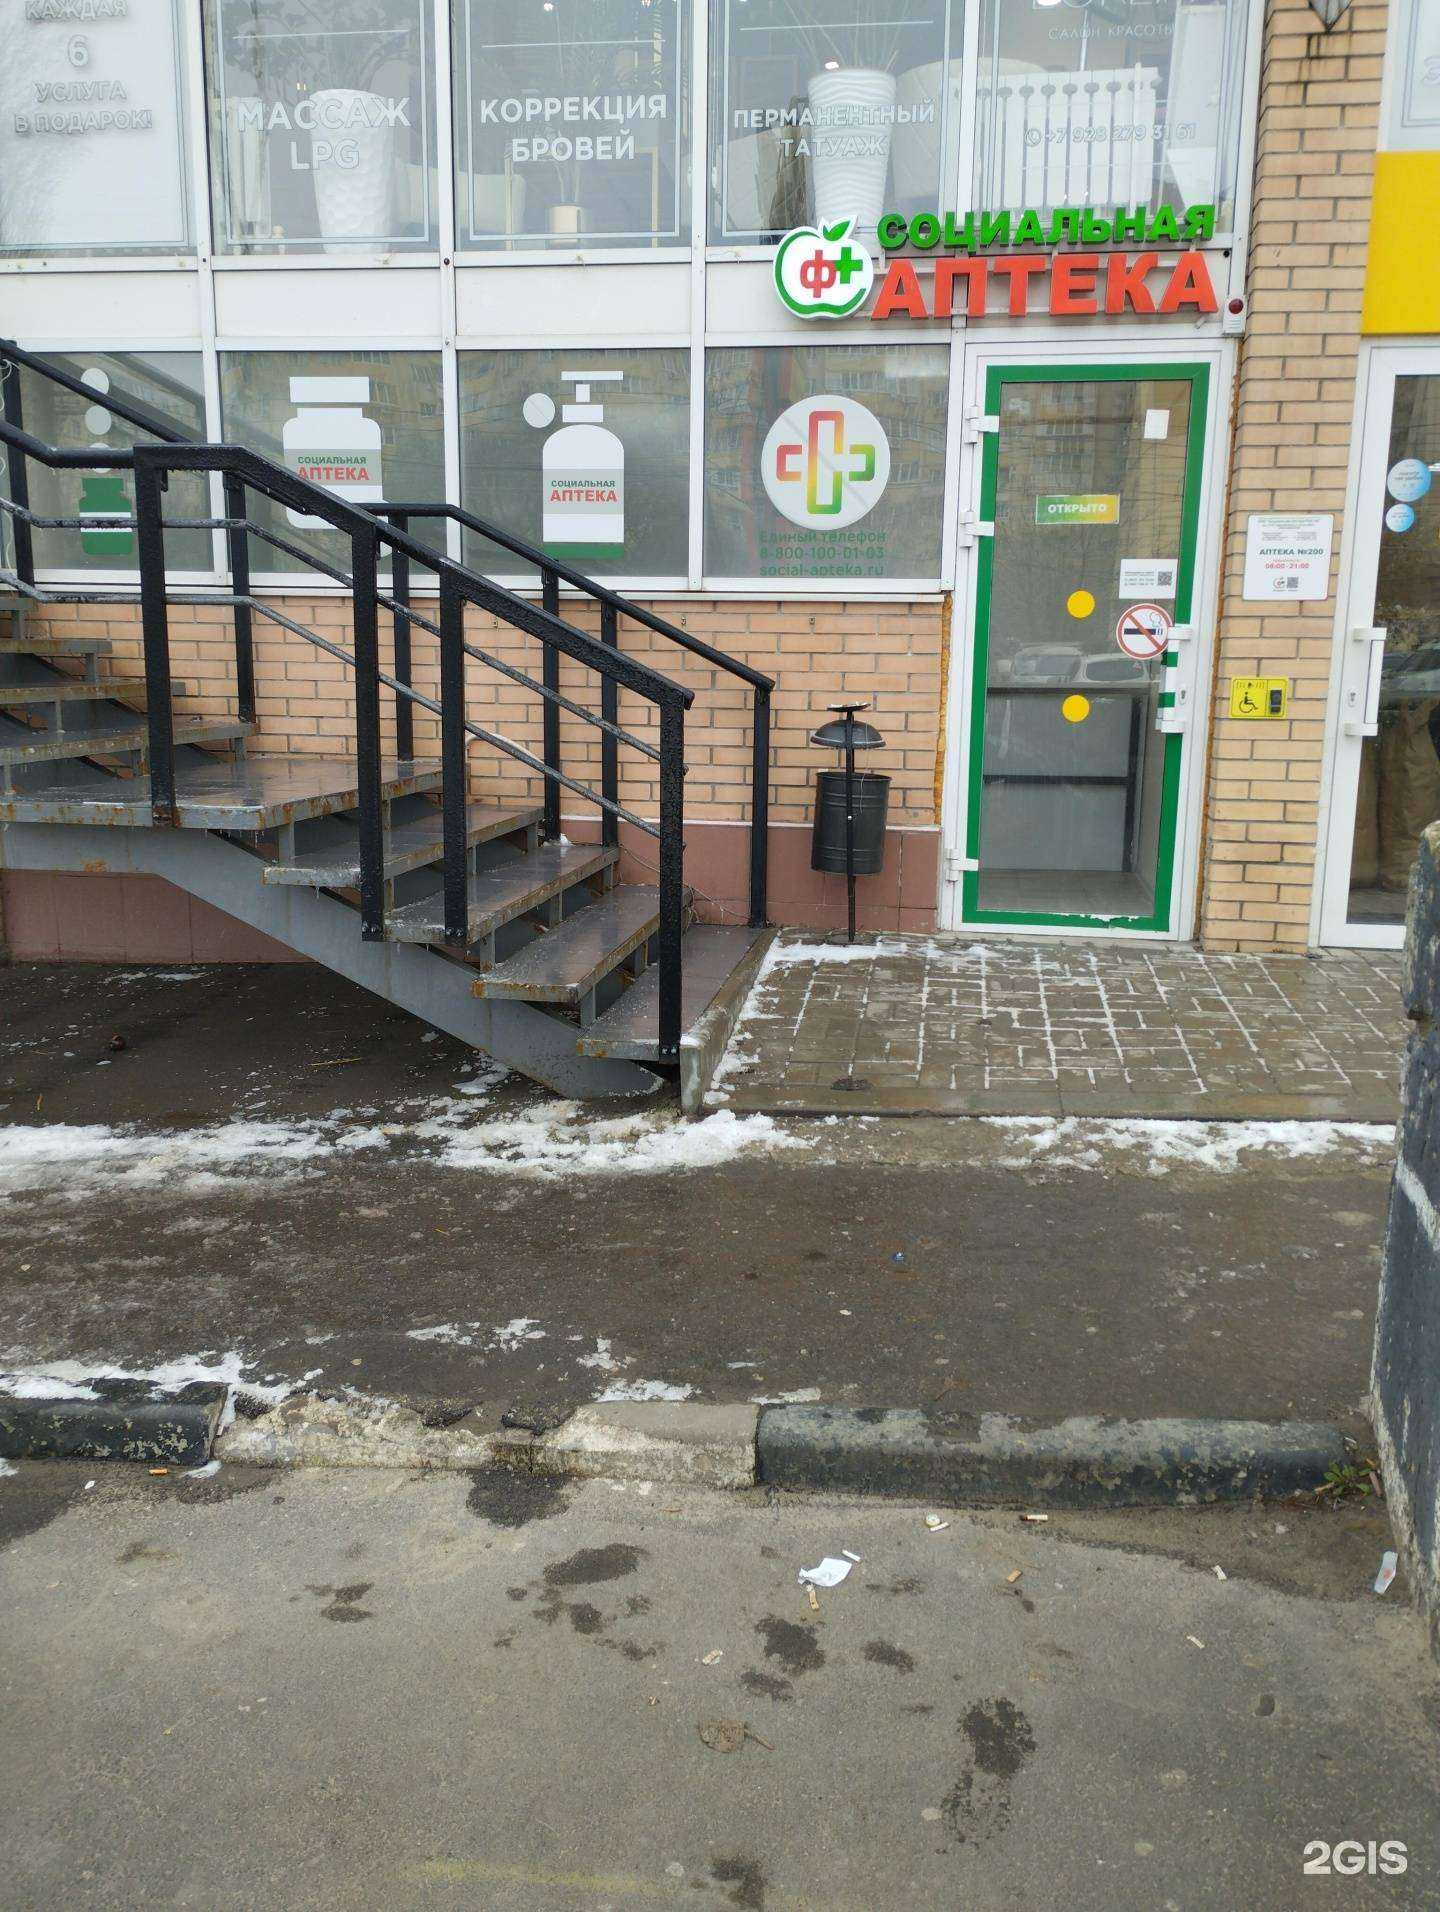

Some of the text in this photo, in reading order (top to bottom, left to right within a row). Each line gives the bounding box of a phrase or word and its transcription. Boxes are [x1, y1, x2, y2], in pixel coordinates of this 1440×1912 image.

[26, 0, 128, 20] КАЖДАЯ
[68, 34, 89, 67] 6
[34, 80, 127, 102] УСЛУГА
[237, 97, 411, 131] МАССАЖ
[480, 94, 667, 124] КОРРЕКЦИЯ
[734, 98, 935, 128] ПЕРМАНЕНТНЫЙ
[15, 109, 152, 134] В ПОДАРОК!
[290, 139, 360, 170] LPG
[511, 129, 635, 162] БРОВЕЙ
[779, 136, 886, 157] ТАТУАЖ
[877, 204, 1216, 253] СОЦИАЛЬНАЯ
[871, 252, 1218, 319] АПТЕКА
[297, 456, 367, 465] СОЦИАЛЬНАЯ
[297, 466, 369, 481] АПТЕКА
[551, 480, 616, 488] СОЦИАЛЬНАЯ
[550, 489, 618, 502] АПТЕКА
[1047, 503, 1107, 514] ОТКРЫТО
[759, 530, 887, 544] Единый телефон
[759, 546, 885, 560] 8-800-100-01-03
[1259, 548, 1295, 556] АПТЕКА
[759, 562, 884, 577] social-apteka.ru
